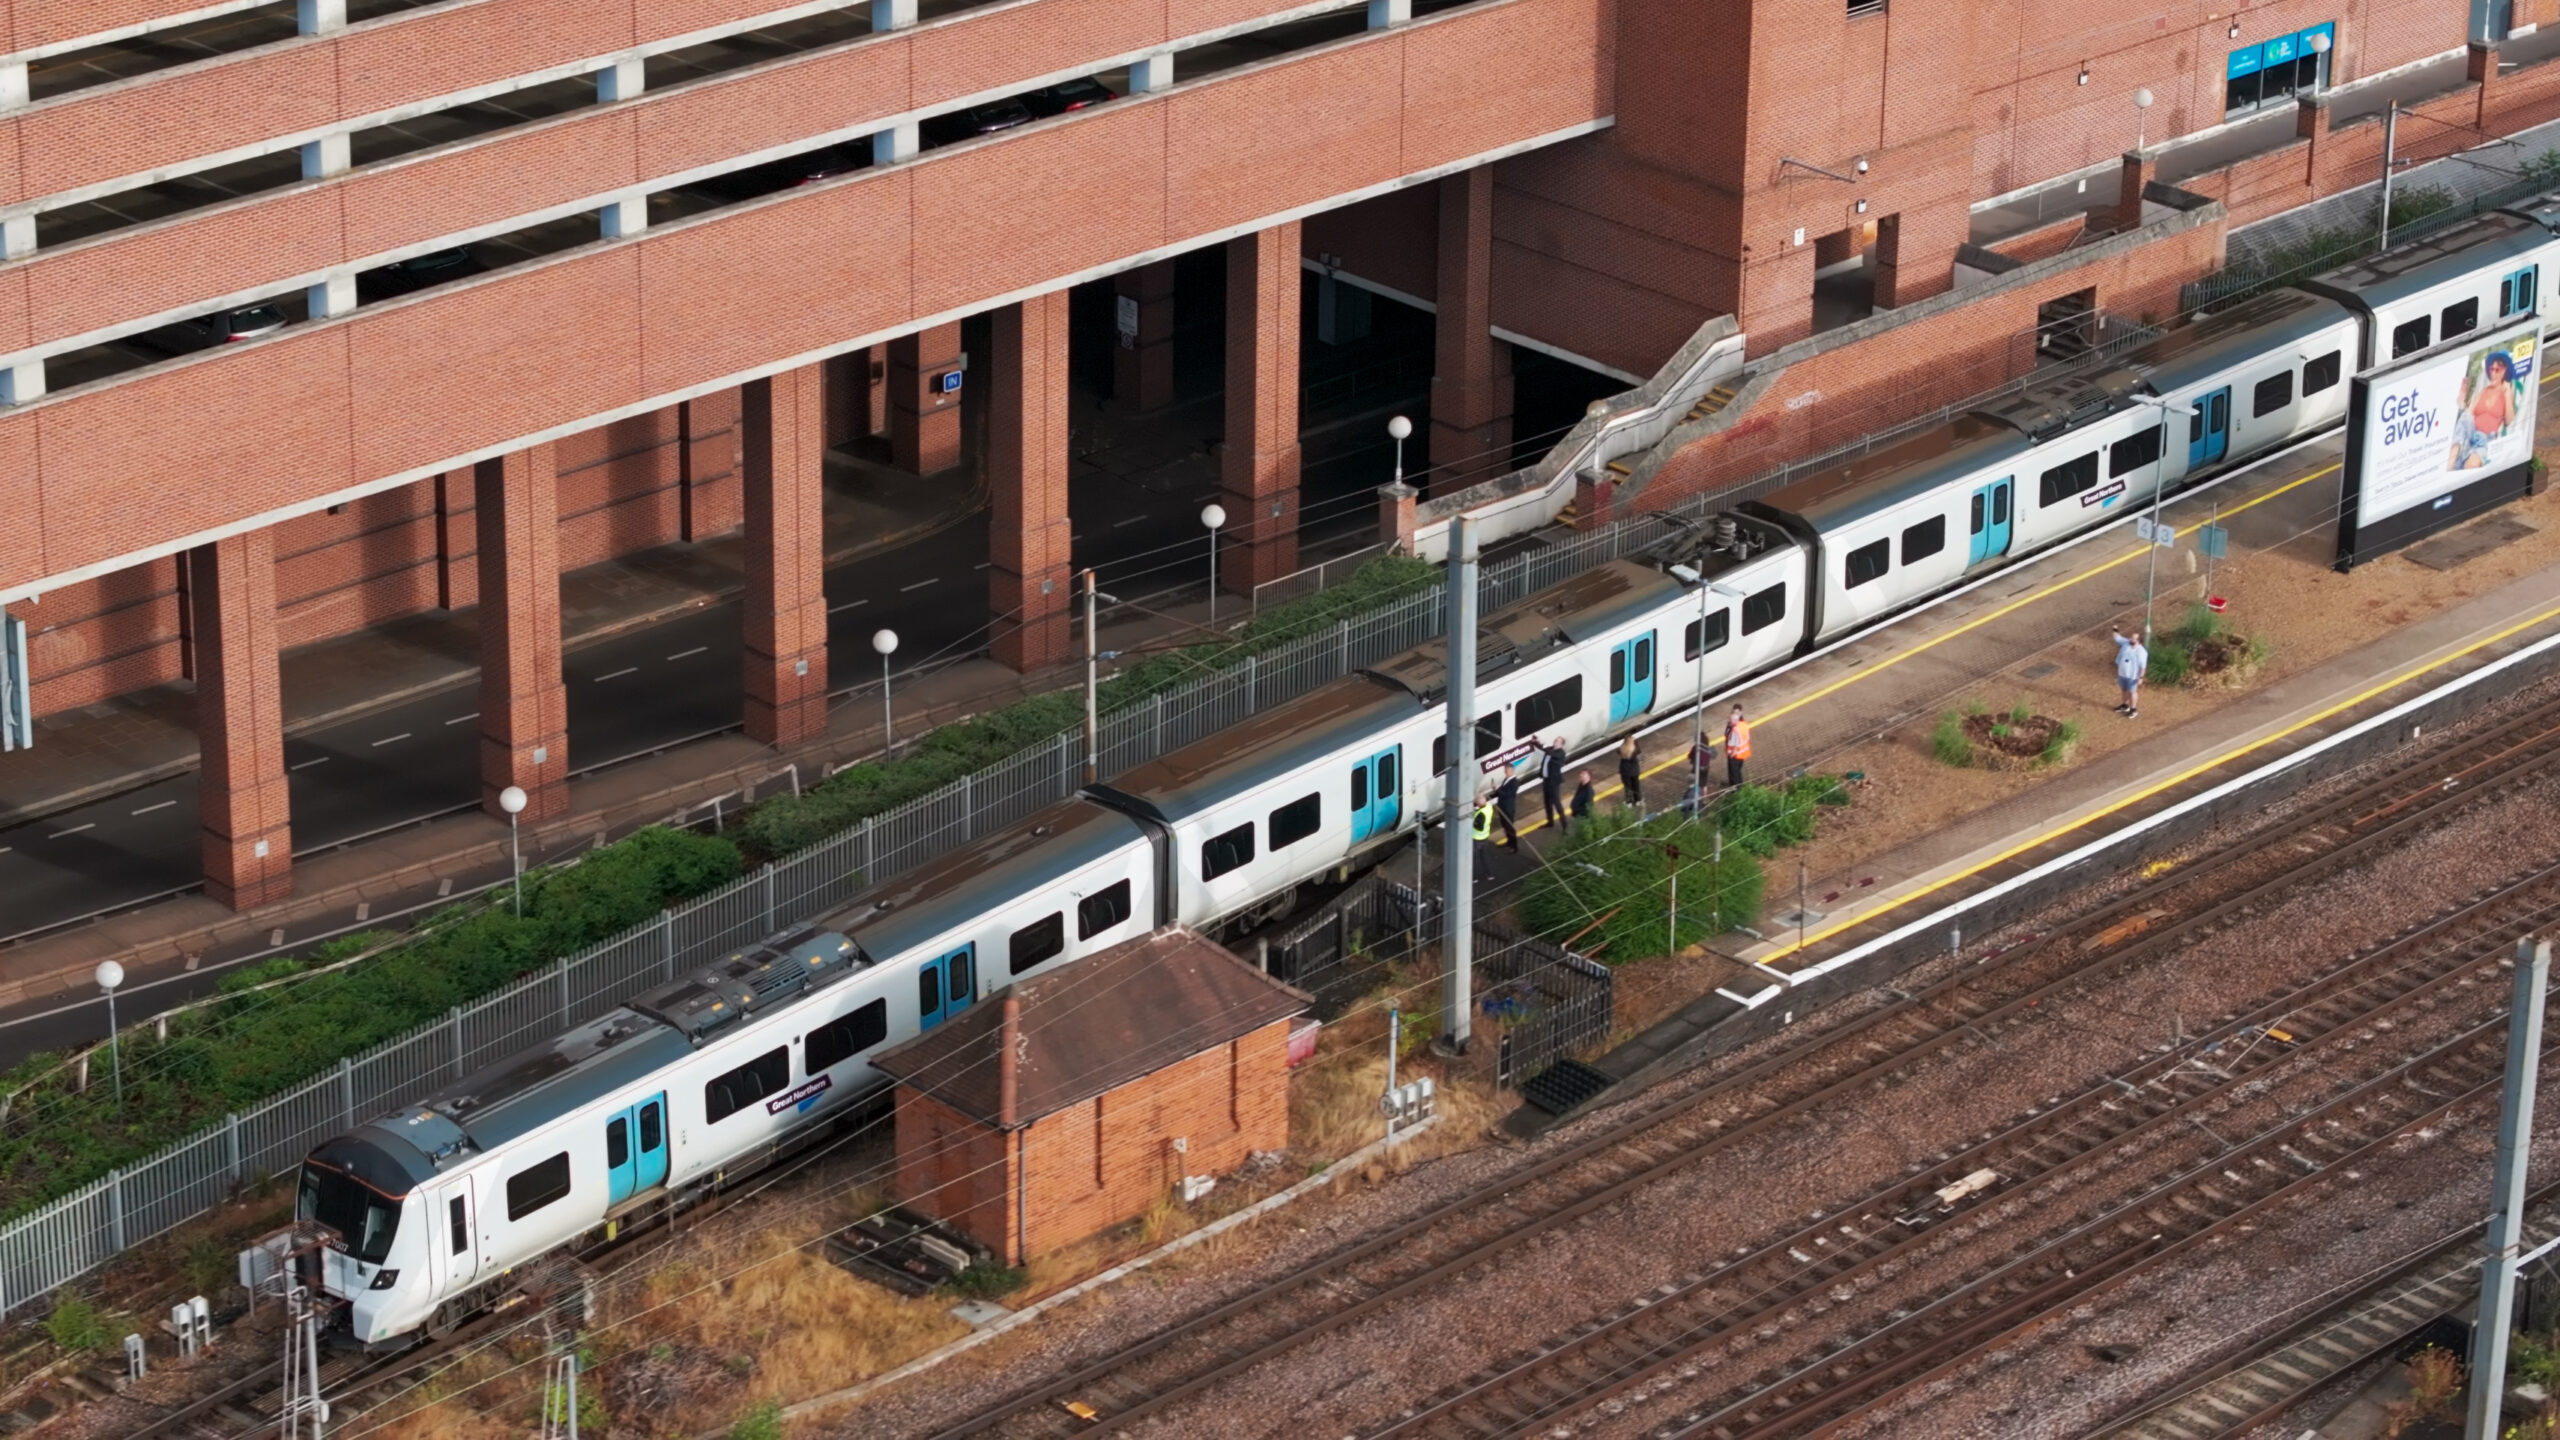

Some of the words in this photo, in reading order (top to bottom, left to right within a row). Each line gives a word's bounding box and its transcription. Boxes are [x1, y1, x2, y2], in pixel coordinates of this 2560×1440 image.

[947, 375, 958, 388] IN
[2381, 388, 2419, 423] Get
[2384, 407, 2439, 446] away.
[2083, 490, 2099, 505] Great
[2099, 483, 2123, 498] Northern
[2140, 521, 2148, 535] 4
[2160, 528, 2170, 543] 3
[1485, 756, 1503, 770] Great
[1503, 744, 1531, 762] Northern
[772, 1095, 793, 1111] Great
[793, 1079, 826, 1100] Northern
